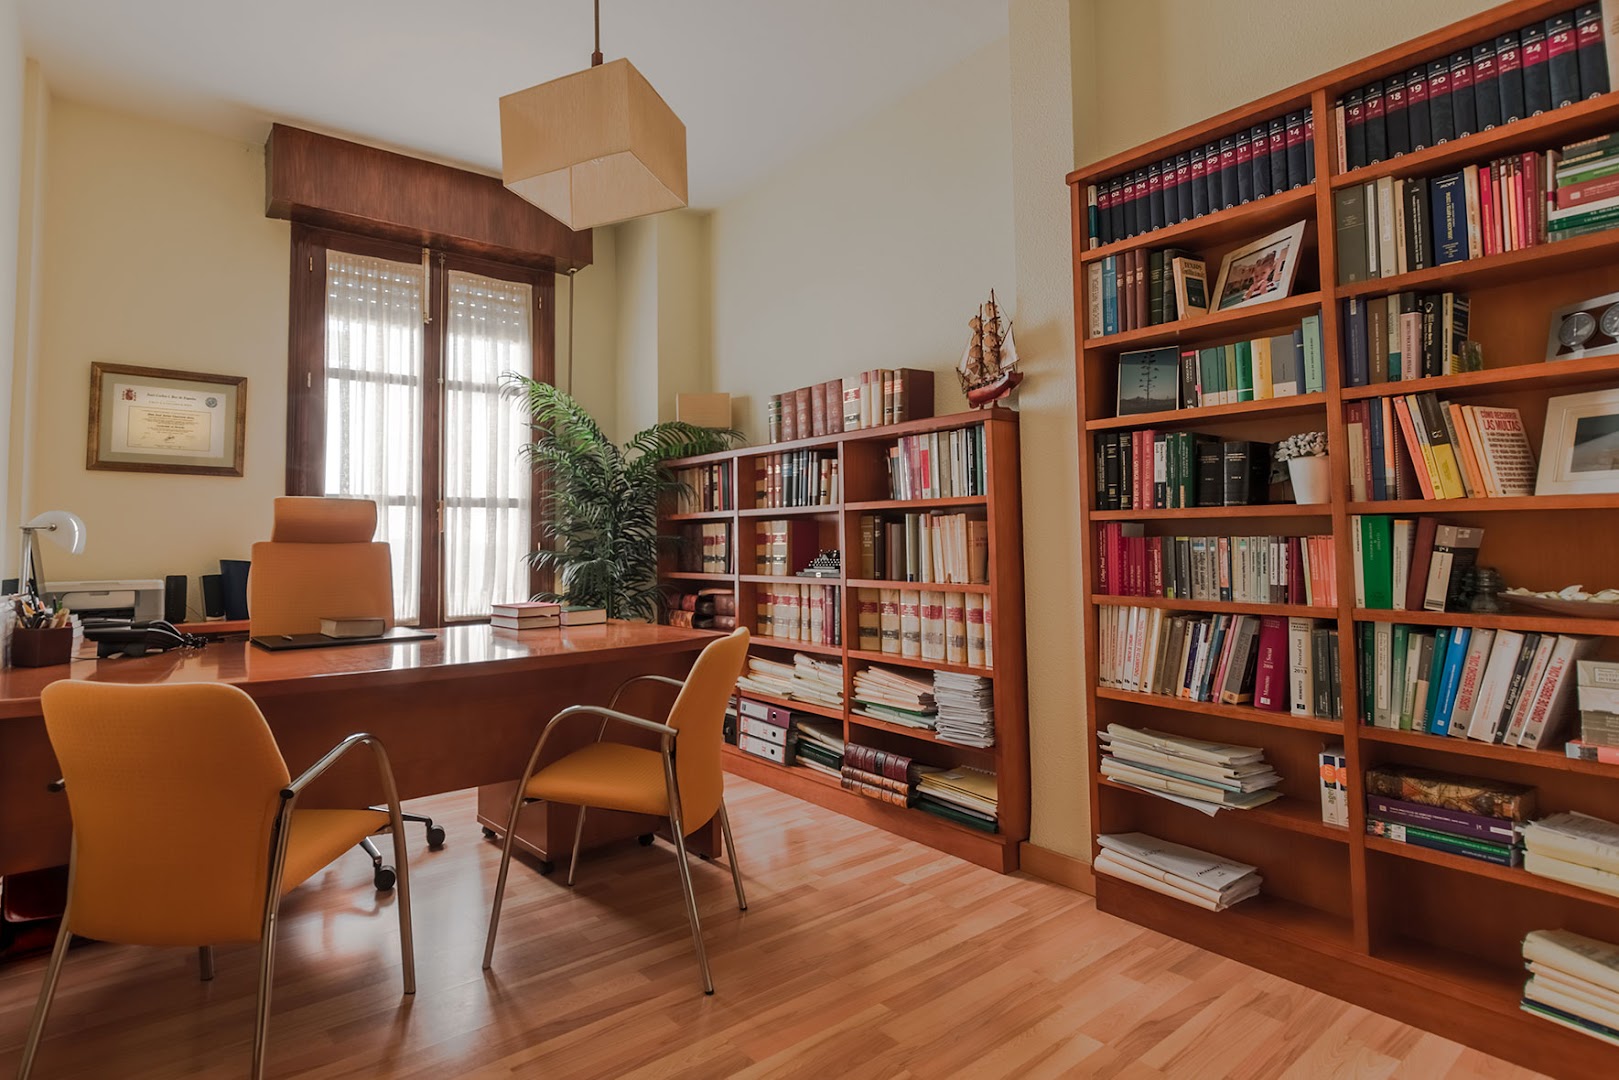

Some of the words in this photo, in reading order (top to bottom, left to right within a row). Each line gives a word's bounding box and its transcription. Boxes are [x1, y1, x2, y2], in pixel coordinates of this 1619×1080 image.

[1581, 24, 1598, 34] 26
[1553, 33, 1568, 43] 25
[1526, 44, 1542, 54] 24
[1501, 51, 1515, 61] 23
[1478, 61, 1492, 70] 22
[1455, 69, 1466, 78] 21
[1432, 77, 1446, 85] 20
[1410, 84, 1422, 93] 19
[1390, 92, 1401, 100] 18
[1349, 108, 1359, 116] 16
[1164, 173, 1174, 181] 06
[1484, 420, 1495, 430] LAS
[1496, 420, 1521, 431] MULTAS
[1464, 668, 1478, 688] DERECHO
[1462, 687, 1473, 697] DE
[1507, 688, 1519, 705] abogado
[1513, 675, 1522, 688] eficaz
[1540, 678, 1557, 701] DERECHO
[1458, 695, 1471, 711] CURSO
[1538, 699, 1549, 707] DE
[1532, 707, 1546, 723] CURSO
